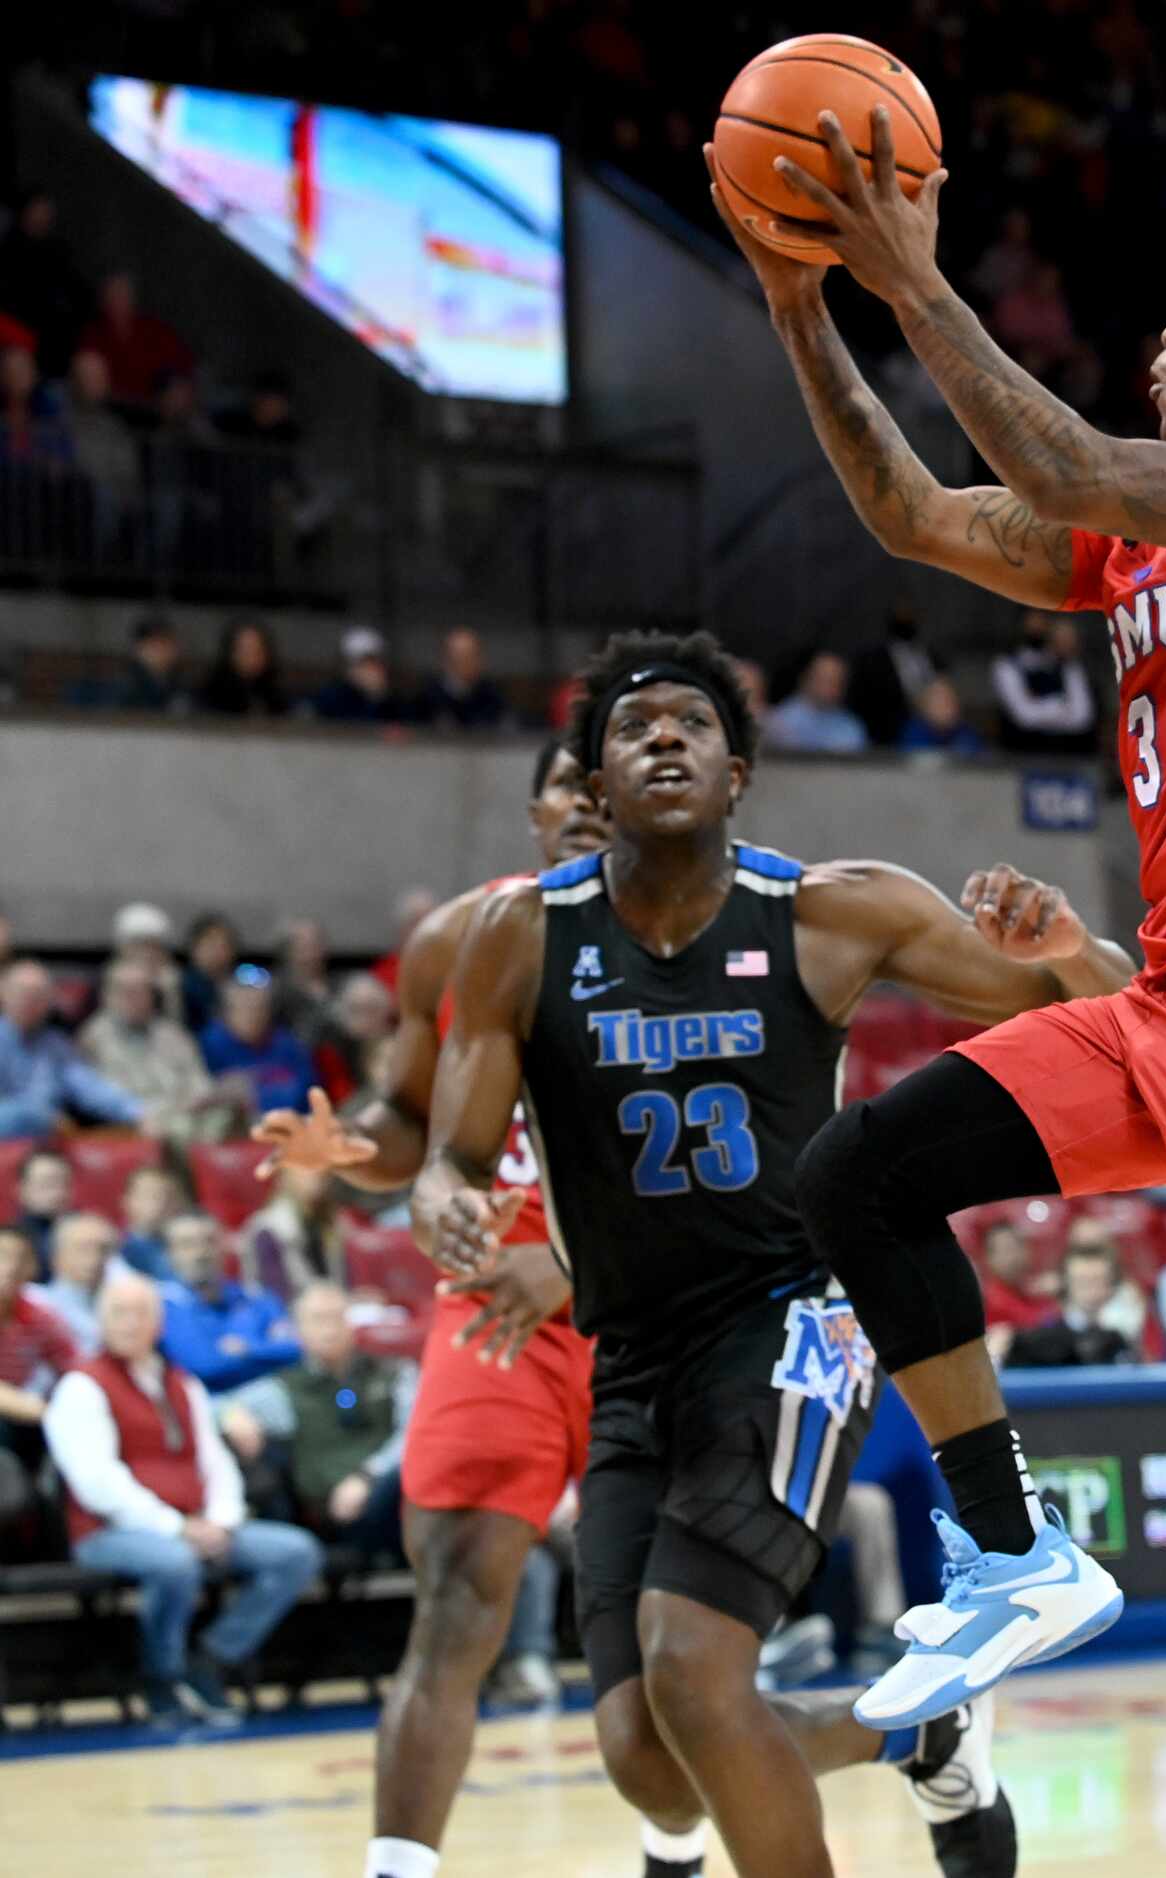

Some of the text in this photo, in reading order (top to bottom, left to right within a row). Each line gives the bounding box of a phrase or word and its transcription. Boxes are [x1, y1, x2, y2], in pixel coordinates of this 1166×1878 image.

[1127, 694, 1162, 808] 3
[587, 1008, 766, 1074] Tigers
[618, 1082, 760, 1198] 23
